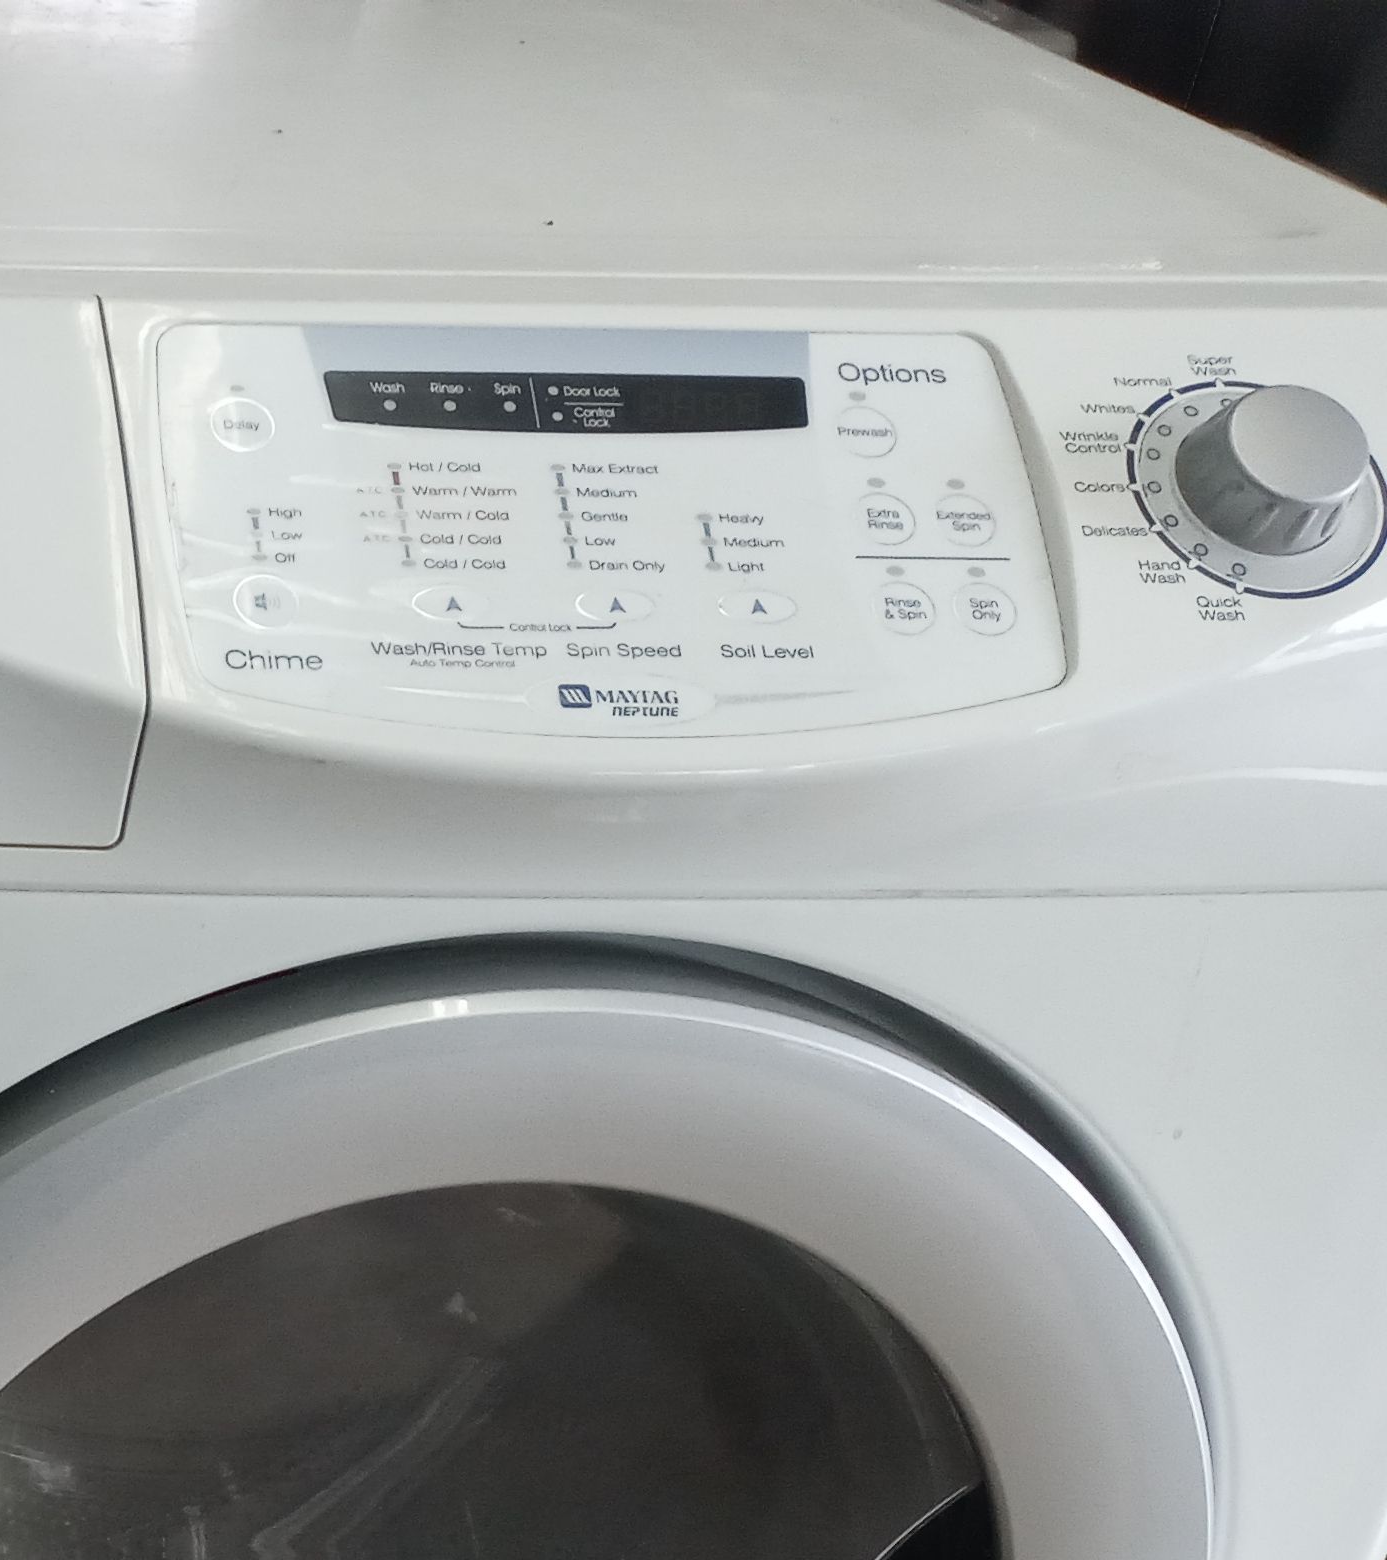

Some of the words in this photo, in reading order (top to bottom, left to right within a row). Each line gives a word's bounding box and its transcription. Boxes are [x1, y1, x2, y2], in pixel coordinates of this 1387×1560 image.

[1186, 355, 1233, 368] Super
[838, 362, 947, 386] Options
[1190, 365, 1237, 376] Wash
[369, 381, 406, 393] Wash
[430, 382, 464, 393] Rinse
[1113, 376, 1172, 388] Normal
[493, 382, 521, 395] Spin
[564, 385, 590, 396] Door
[593, 386, 621, 398] Lock
[573, 407, 616, 419] Control
[1080, 403, 1136, 415] Whites
[583, 418, 610, 428] Lock
[838, 427, 893, 437] Prewash
[1060, 431, 1119, 443] Wrinkle
[1065, 442, 1122, 454] Control
[409, 462, 434, 471] Hot
[447, 462, 481, 472] Cold
[572, 464, 603, 474] Max
[608, 464, 658, 475] Extract
[412, 486, 458, 495] Warm
[471, 487, 517, 496] Warm
[577, 487, 637, 499] Medium
[1074, 481, 1125, 493] Colors
[268, 506, 302, 519] High
[416, 510, 462, 519] Warm
[581, 510, 628, 522] Gentle
[867, 508, 900, 520] Extra
[936, 509, 992, 521] Extended
[719, 512, 764, 526] Heavy
[868, 520, 904, 530] Rinse
[952, 521, 981, 533] Spin
[1081, 525, 1148, 538] Delicates
[271, 531, 302, 541] Low
[420, 534, 454, 544] Cold
[468, 534, 501, 544] Cold
[585, 536, 615, 547] Low
[723, 537, 784, 549] Medium
[276, 553, 296, 563] Off
[424, 558, 457, 569] Cold
[472, 559, 506, 569] Cold
[589, 560, 627, 571] Drain
[631, 560, 666, 573] Only
[728, 561, 765, 574] Light
[1139, 560, 1181, 571] Hand
[1139, 572, 1186, 584] Wash
[885, 598, 922, 608] Rinse
[969, 598, 999, 610] Spin
[1197, 596, 1243, 610] Quick
[899, 609, 928, 620] Spin
[972, 609, 1002, 622] Only
[1198, 610, 1245, 622] Wash
[372, 641, 486, 659] Wash/Rinse
[492, 642, 548, 661] Temp
[567, 642, 612, 661] Spin
[617, 643, 682, 661] Speed
[720, 644, 757, 659] Soil
[762, 644, 815, 660] Level
[225, 649, 323, 672] Chime
[410, 659, 437, 667] Auto
[440, 659, 471, 669] Temp
[475, 659, 515, 668] Control
[595, 689, 679, 704] MAYTAG
